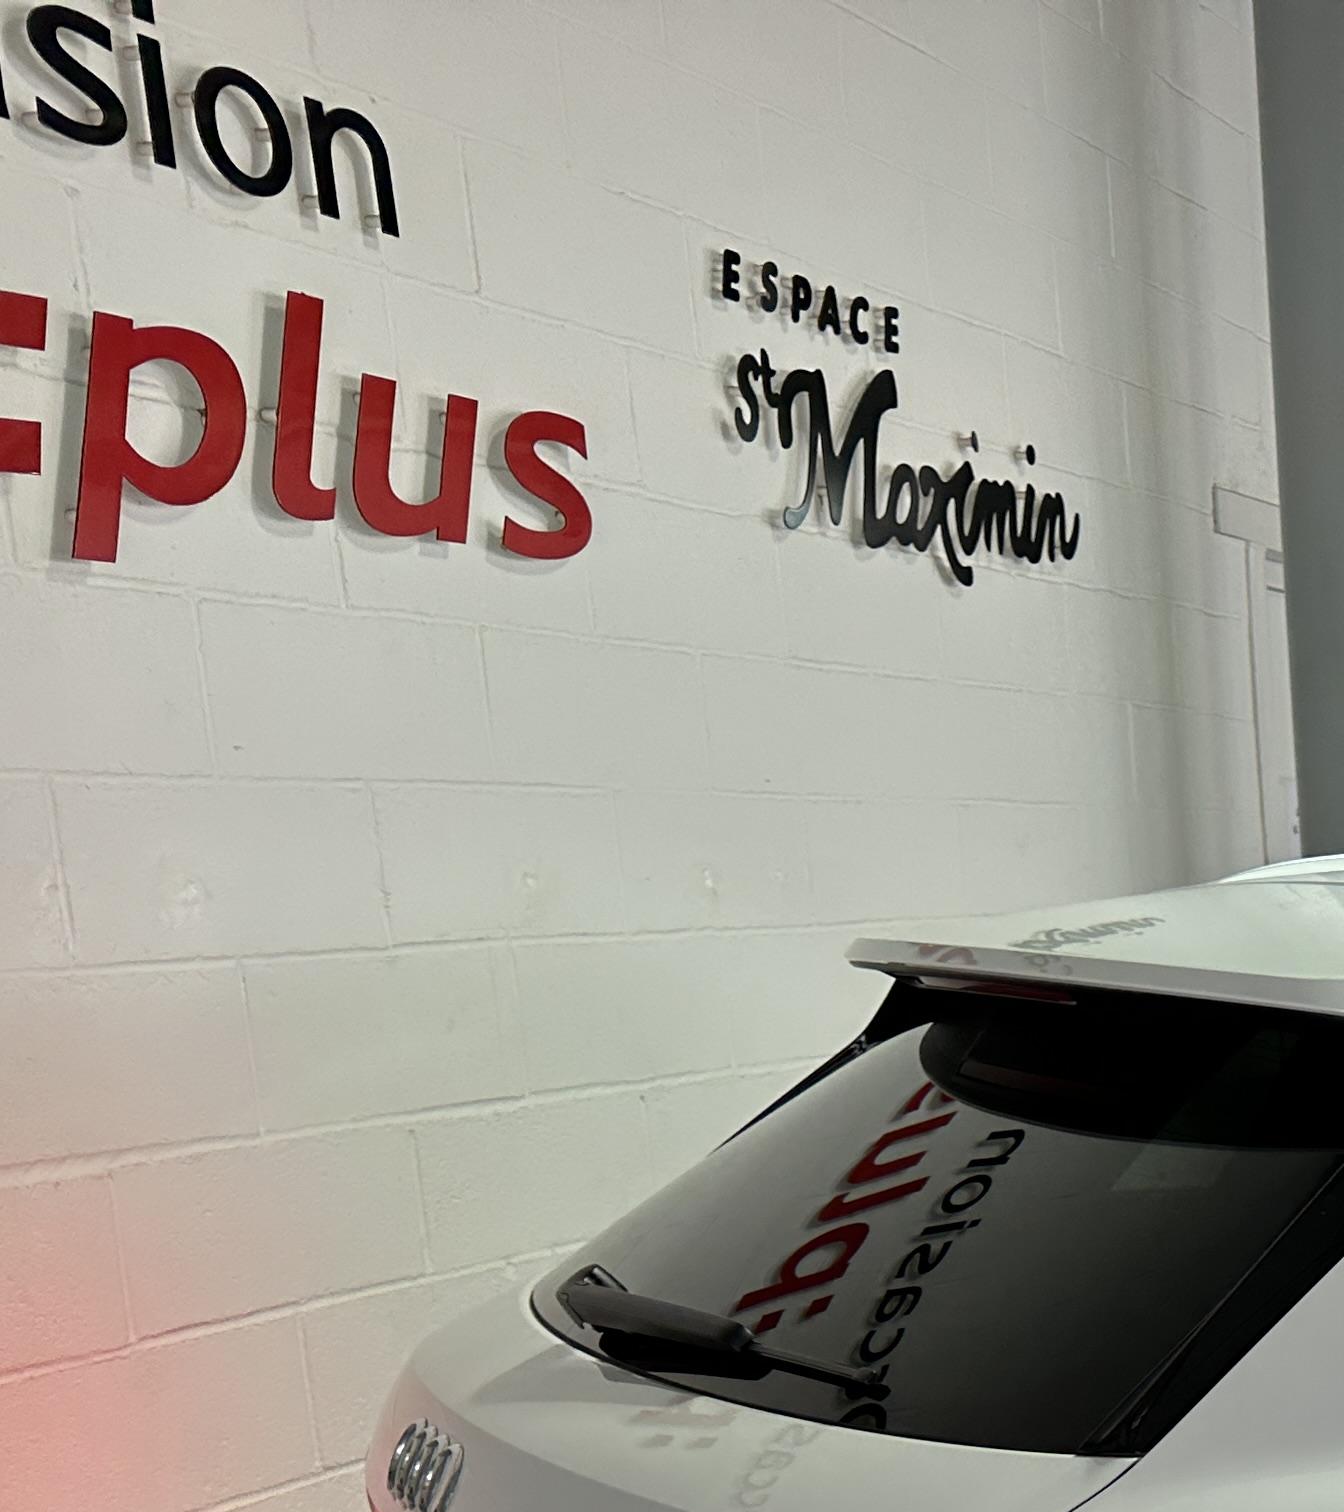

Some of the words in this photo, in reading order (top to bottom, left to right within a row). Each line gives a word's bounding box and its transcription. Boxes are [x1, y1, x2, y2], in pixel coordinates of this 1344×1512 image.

[0, 0, 400, 238] sion
[722, 248, 900, 354] ESPACE
[777, 368, 1081, 587] Maximin
